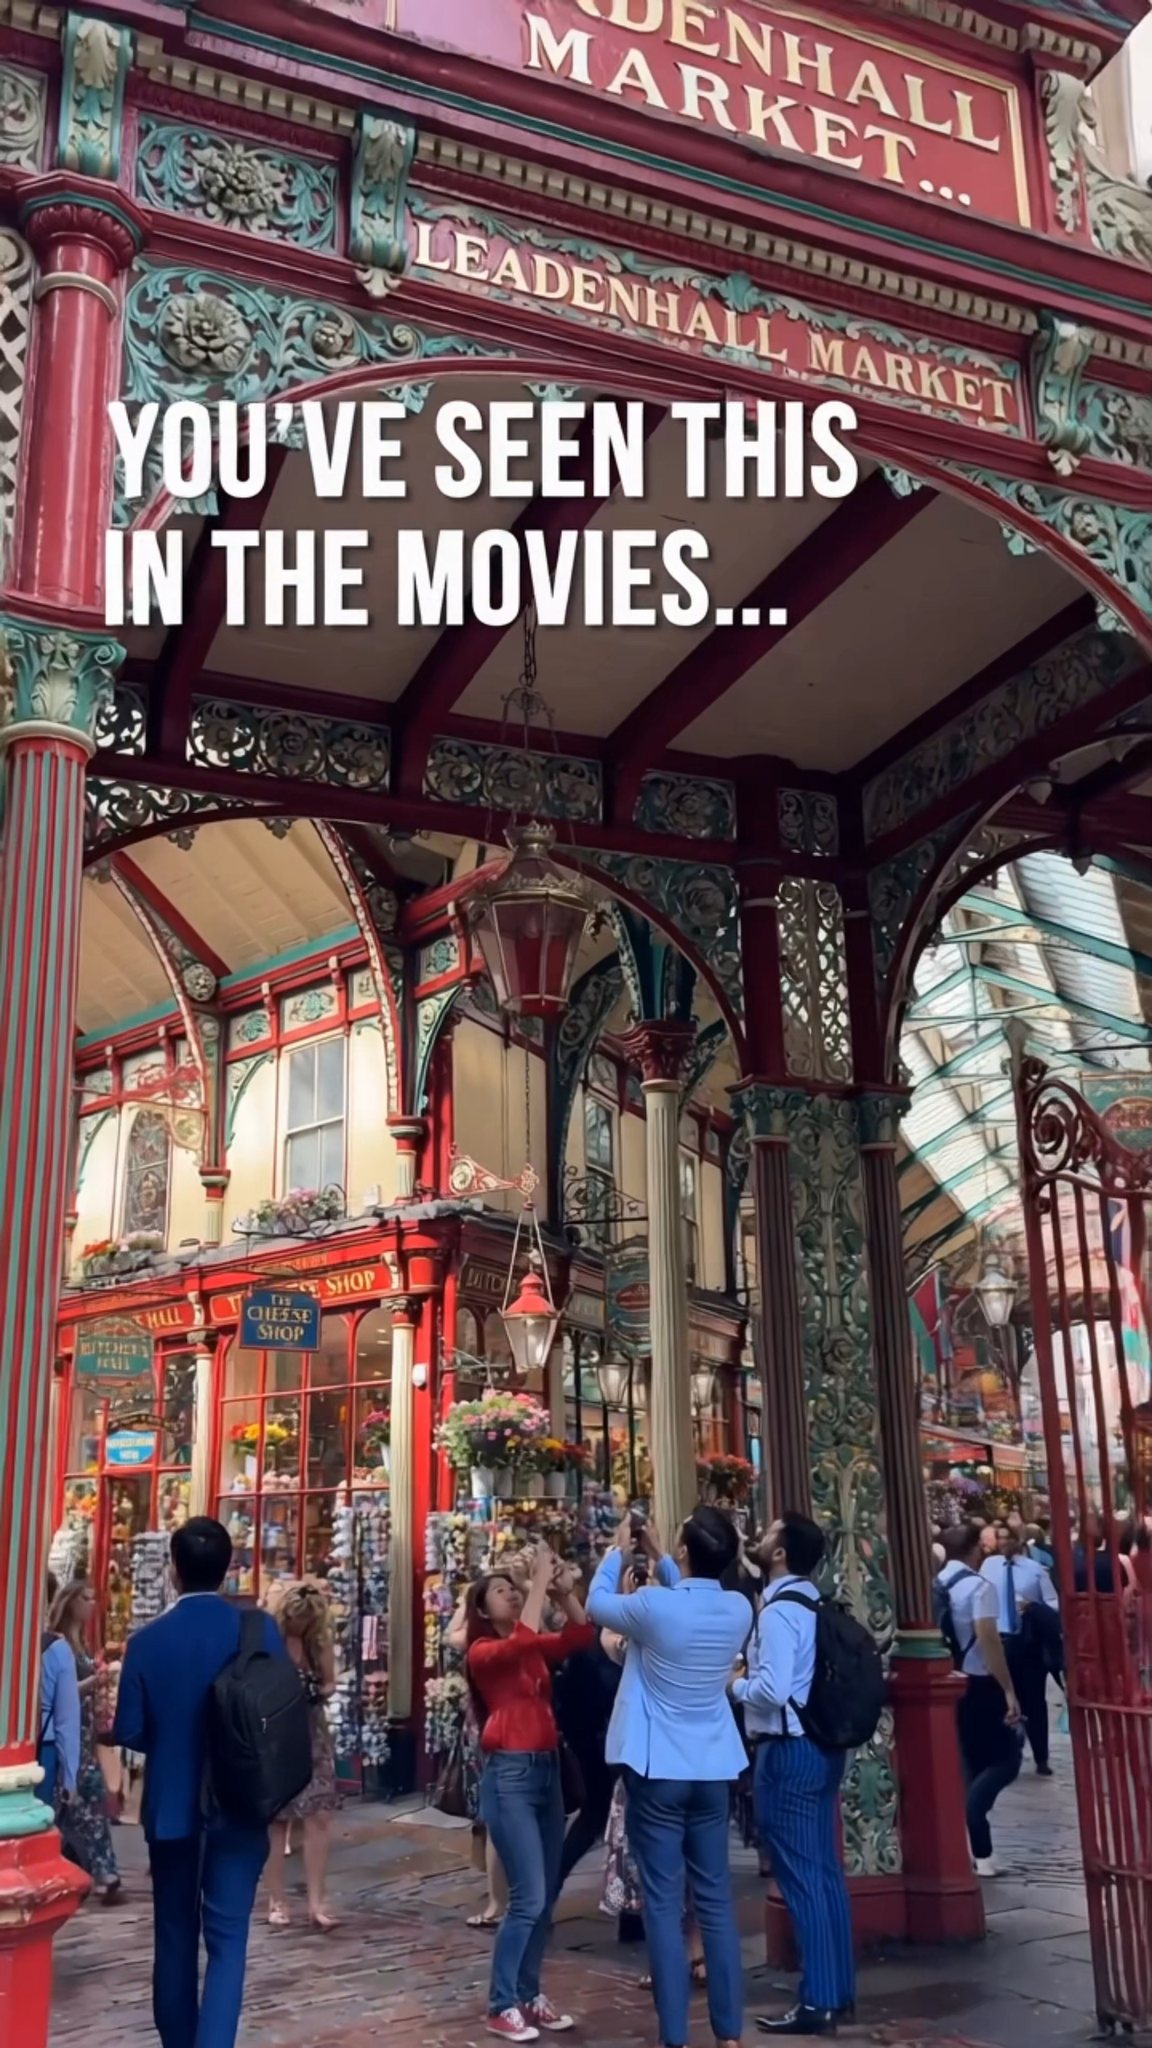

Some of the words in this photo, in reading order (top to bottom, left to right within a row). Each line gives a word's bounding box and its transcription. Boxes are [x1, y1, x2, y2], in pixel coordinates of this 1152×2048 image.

[576, 0, 999, 152] DENHALL
[412, 219, 788, 363] LEADENHALL
[808, 329, 1012, 429] MARKET
[256, 1323, 305, 1341] SHOP
